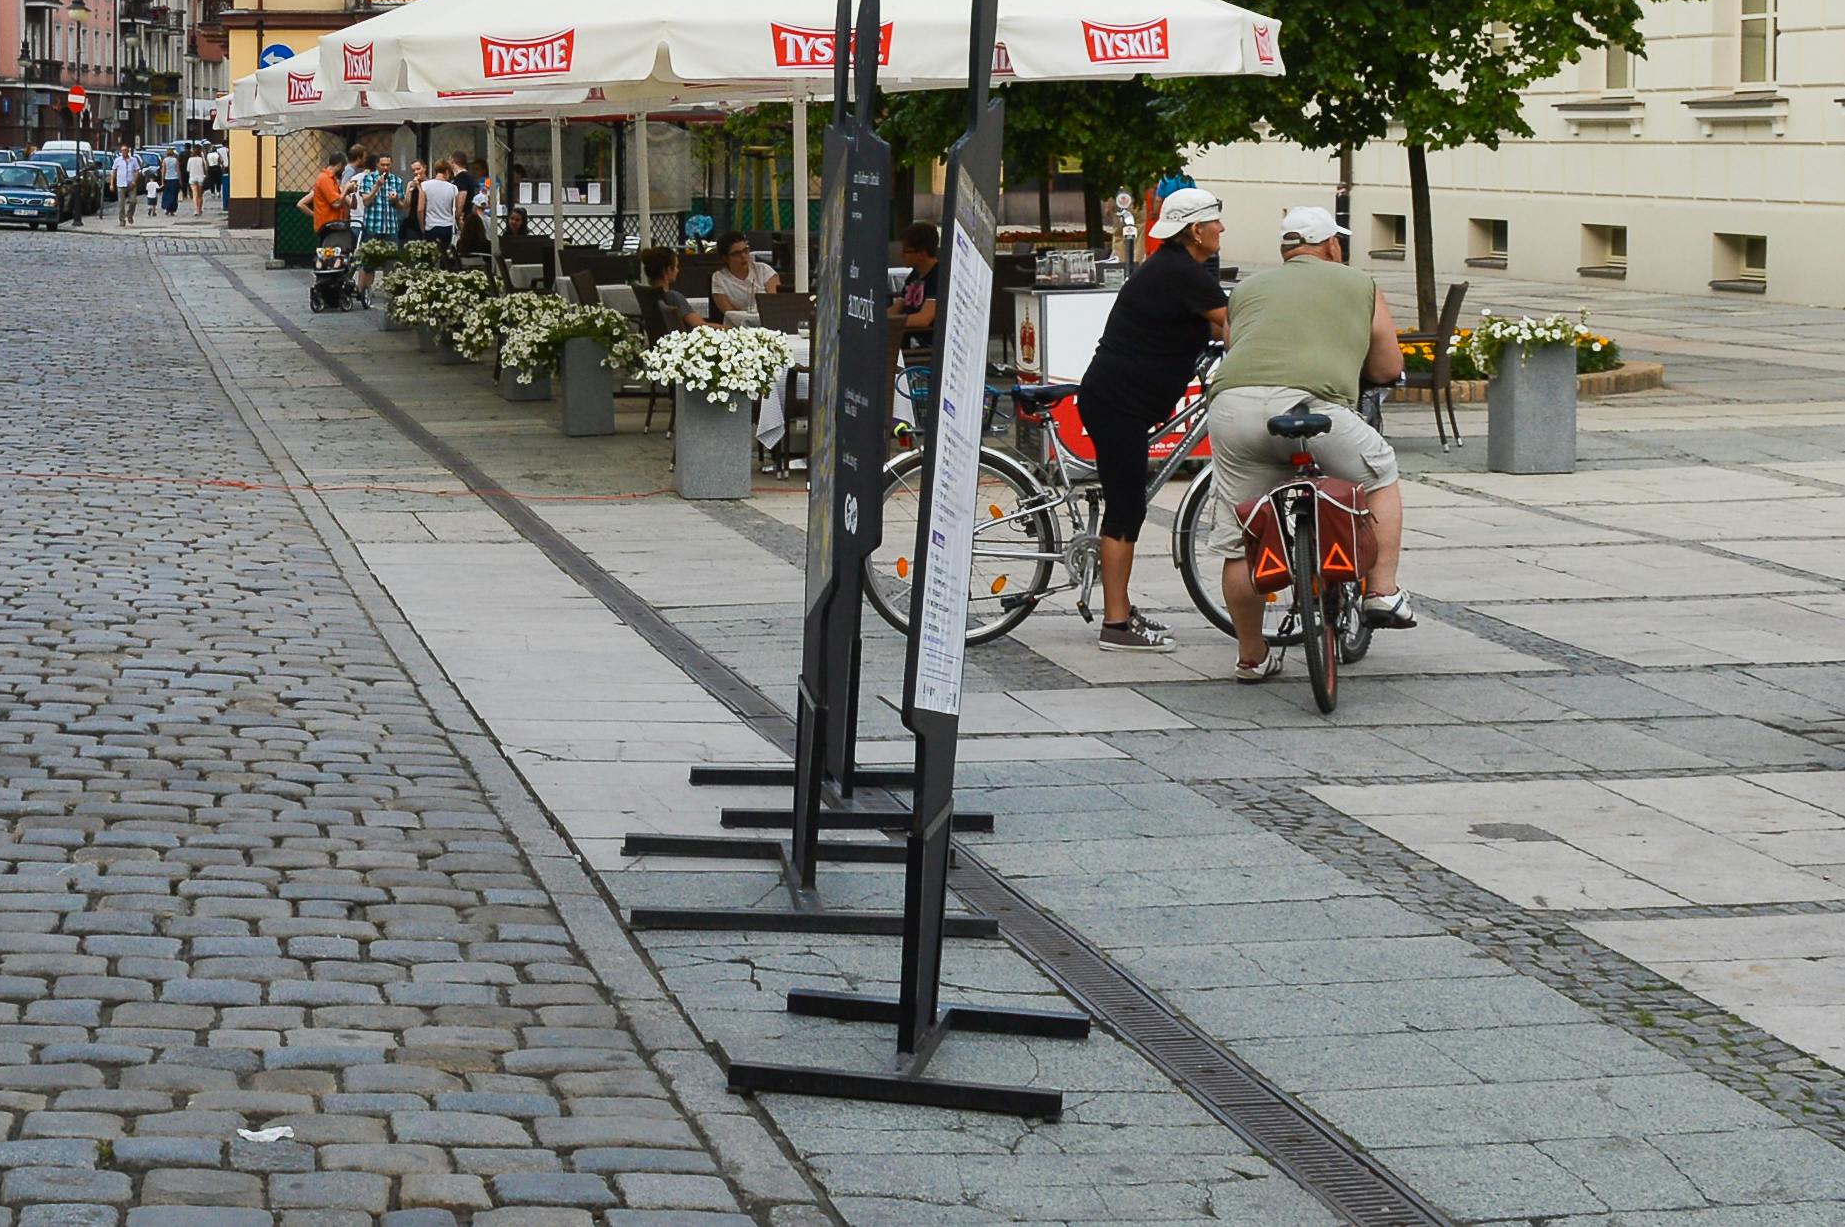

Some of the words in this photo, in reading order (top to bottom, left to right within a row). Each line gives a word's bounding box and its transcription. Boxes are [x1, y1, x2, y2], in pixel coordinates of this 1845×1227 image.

[488, 38, 567, 73] TYSKIE
[1089, 26, 1164, 59] TYSKIE
[346, 51, 371, 77] TYSKIE
